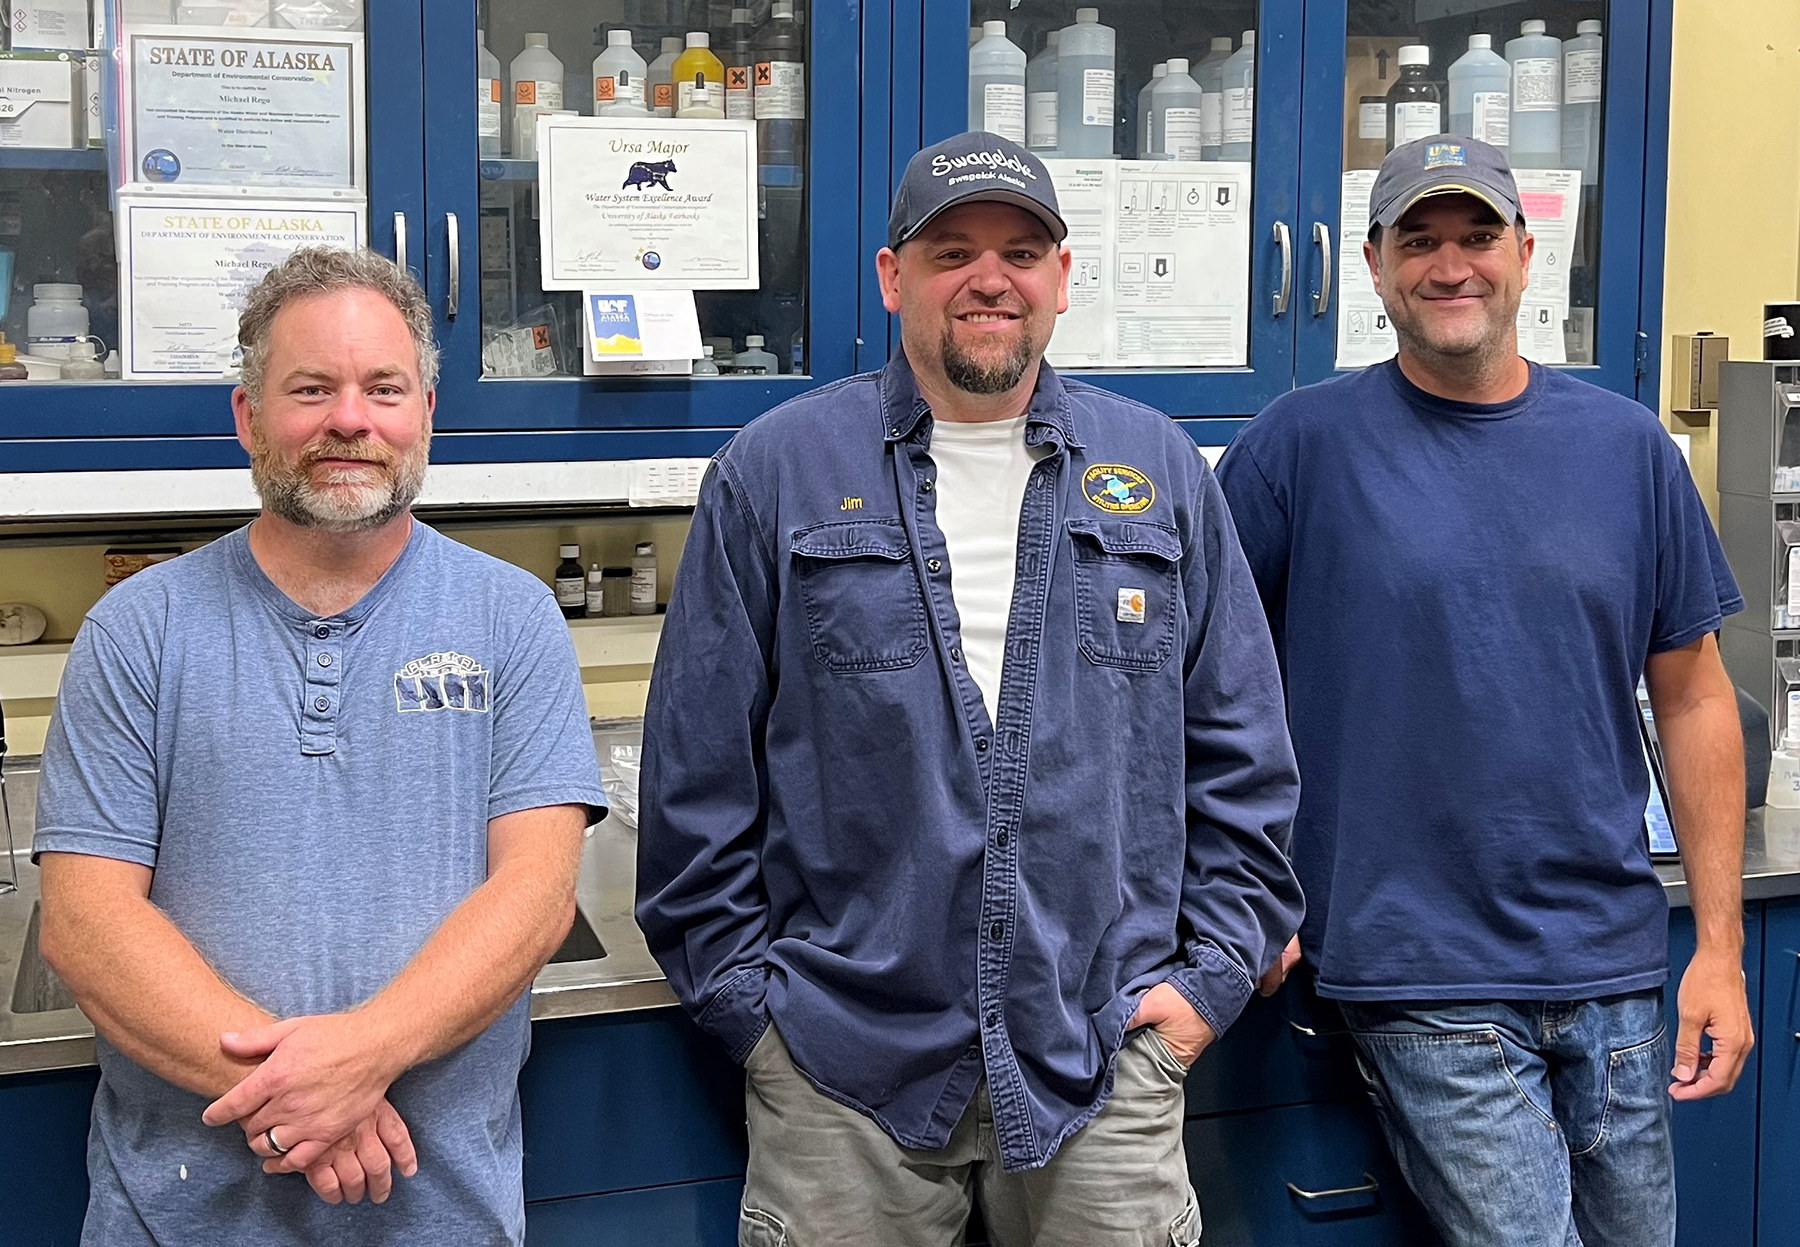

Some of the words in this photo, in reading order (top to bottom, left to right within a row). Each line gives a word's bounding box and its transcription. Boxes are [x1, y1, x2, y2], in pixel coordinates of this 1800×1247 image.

[150, 46, 214, 66] STATE
[220, 49, 248, 68] OF
[253, 51, 335, 71] ALASKA
[608, 138, 642, 153] Ursa
[647, 140, 690, 158] Major
[1430, 144, 1460, 156] UAF
[932, 148, 1037, 180] Swagelok
[948, 170, 996, 186] Swagelok
[998, 173, 1027, 188] Alaska
[585, 193, 610, 202] Water
[612, 194, 640, 204] System
[642, 194, 683, 203] Excellence
[684, 193, 713, 203] Award
[164, 216, 222, 229] STATE
[227, 217, 251, 230] OF
[255, 218, 323, 231] ALASKA
[636, 212, 644, 220] of
[251, 260, 272, 269] Rego
[597, 300, 628, 313] UAF
[1087, 467, 1112, 482] FACILITY
[1114, 468, 1146, 484] SERVICES
[841, 496, 862, 510] Jim
[1092, 494, 1120, 510] UTILITIES
[406, 652, 474, 674] ALASKA
